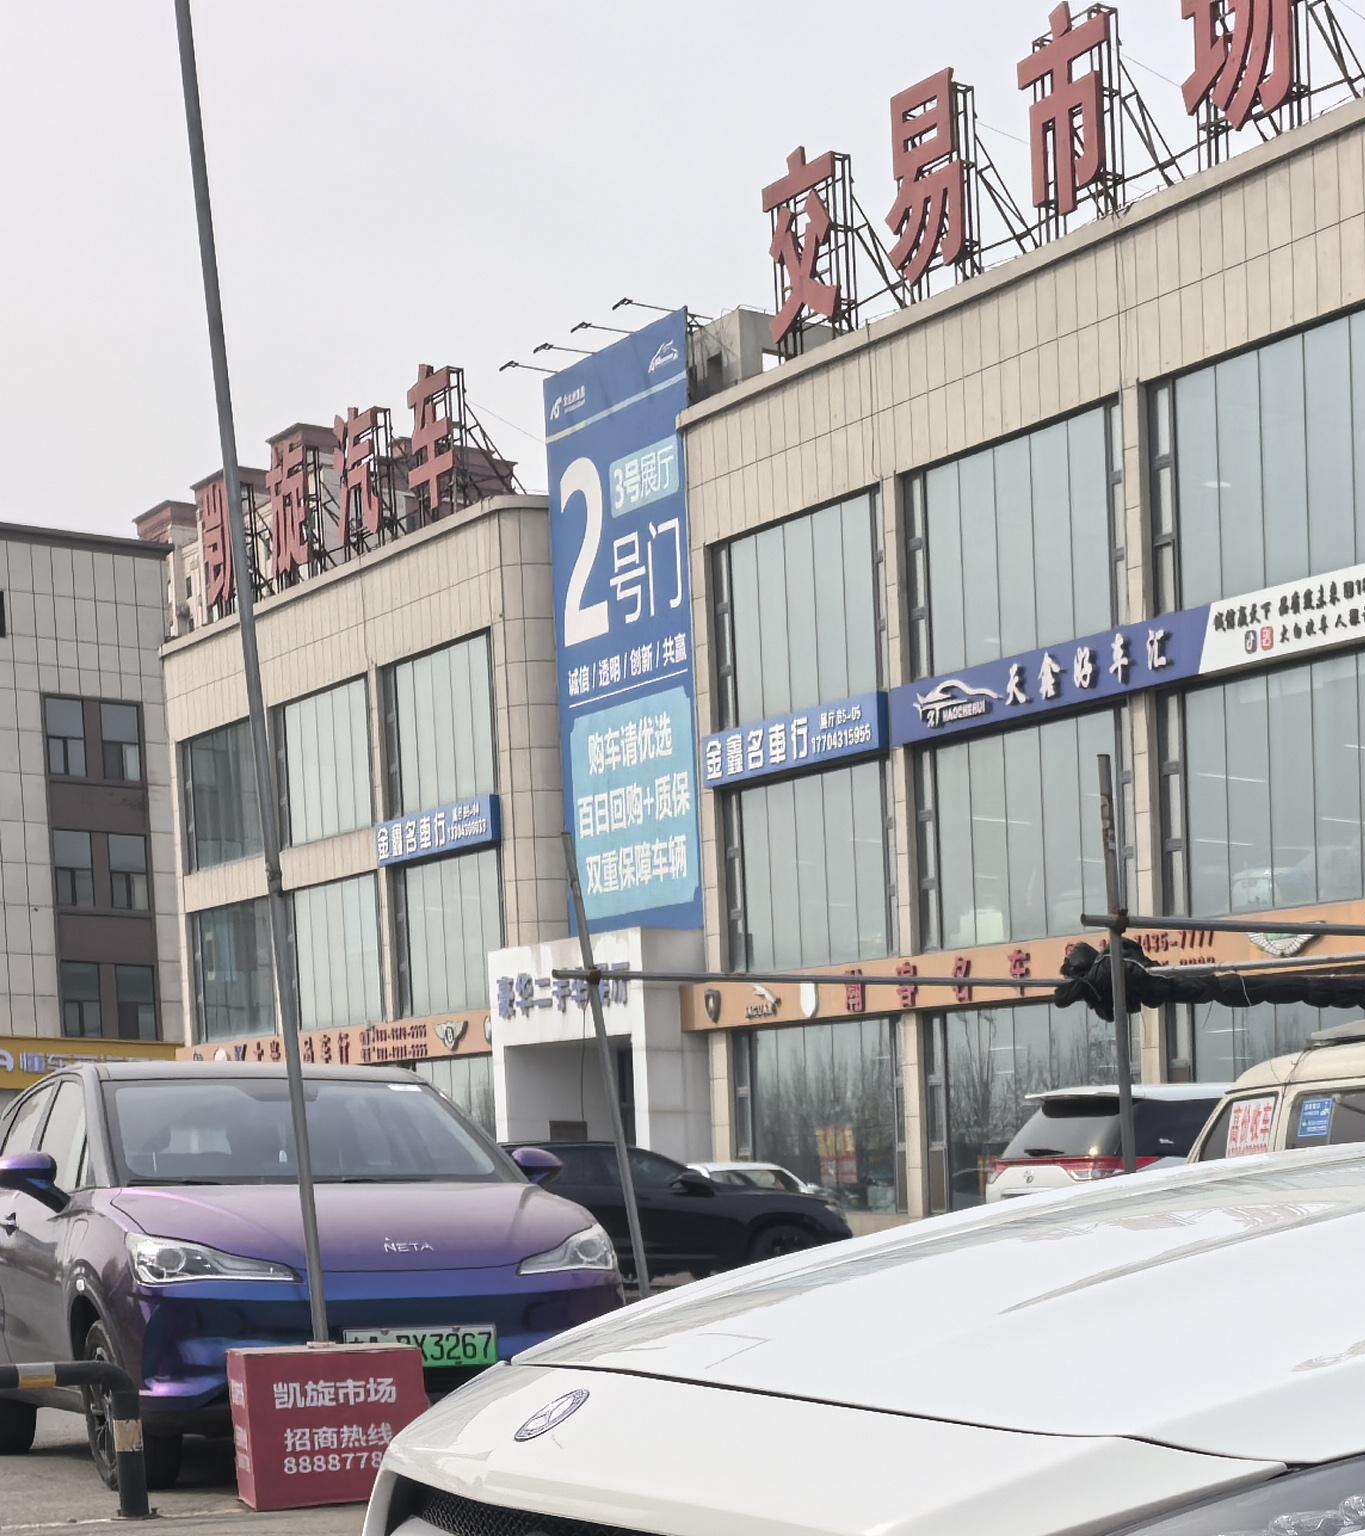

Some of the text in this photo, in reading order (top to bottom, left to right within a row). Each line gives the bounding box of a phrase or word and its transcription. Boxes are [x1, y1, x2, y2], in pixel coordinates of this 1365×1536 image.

[614, 445, 675, 509] 3号展厅
[587, 711, 673, 776] 购车请优选
[577, 771, 691, 839] 百日回购+质保
[585, 834, 688, 895] 双重保障车辆
[384, 1241, 434, 1252] NETA
[273, 1377, 397, 1409] 凯旋市场
[284, 1422, 394, 1452] 招商热线
